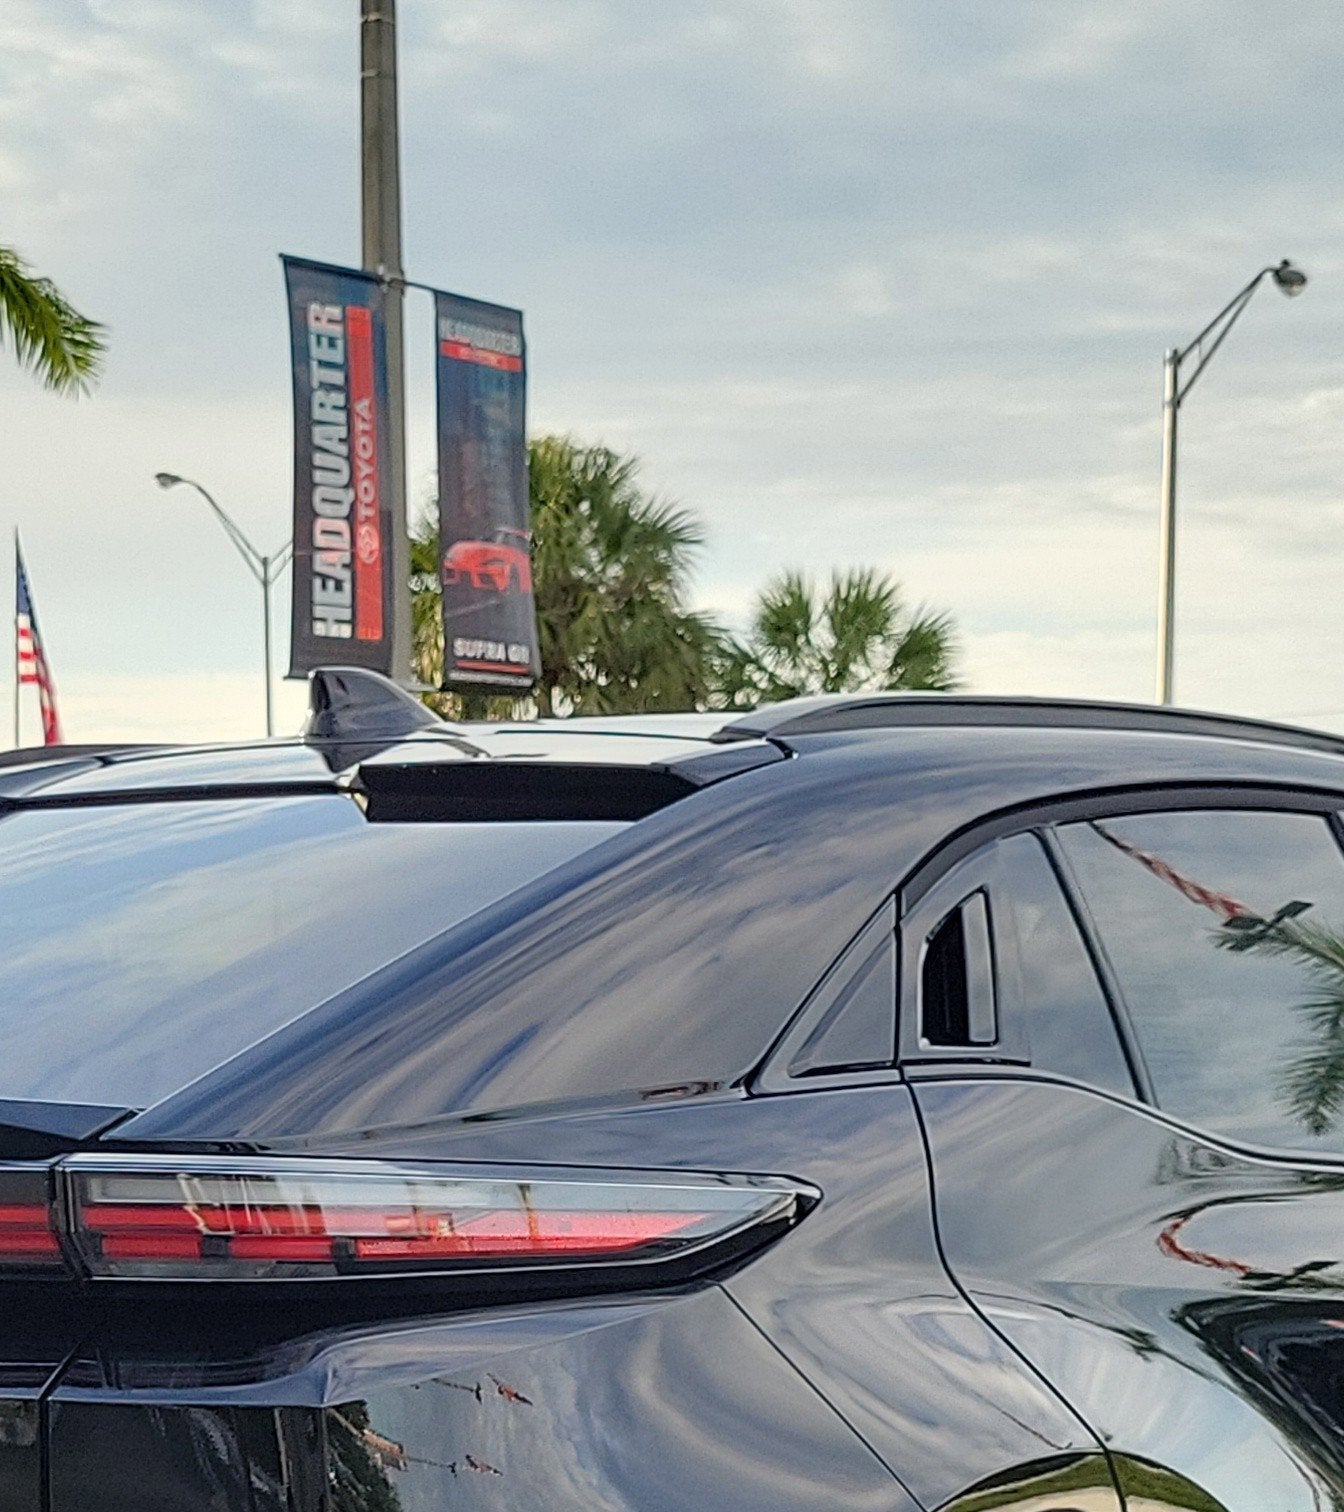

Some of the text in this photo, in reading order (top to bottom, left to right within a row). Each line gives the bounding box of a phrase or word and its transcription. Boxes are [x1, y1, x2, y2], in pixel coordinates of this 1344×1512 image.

[308, 302, 356, 639] HEADQUARTER
[354, 398, 380, 522] TOYOTA
[454, 637, 506, 662] SUPRA
